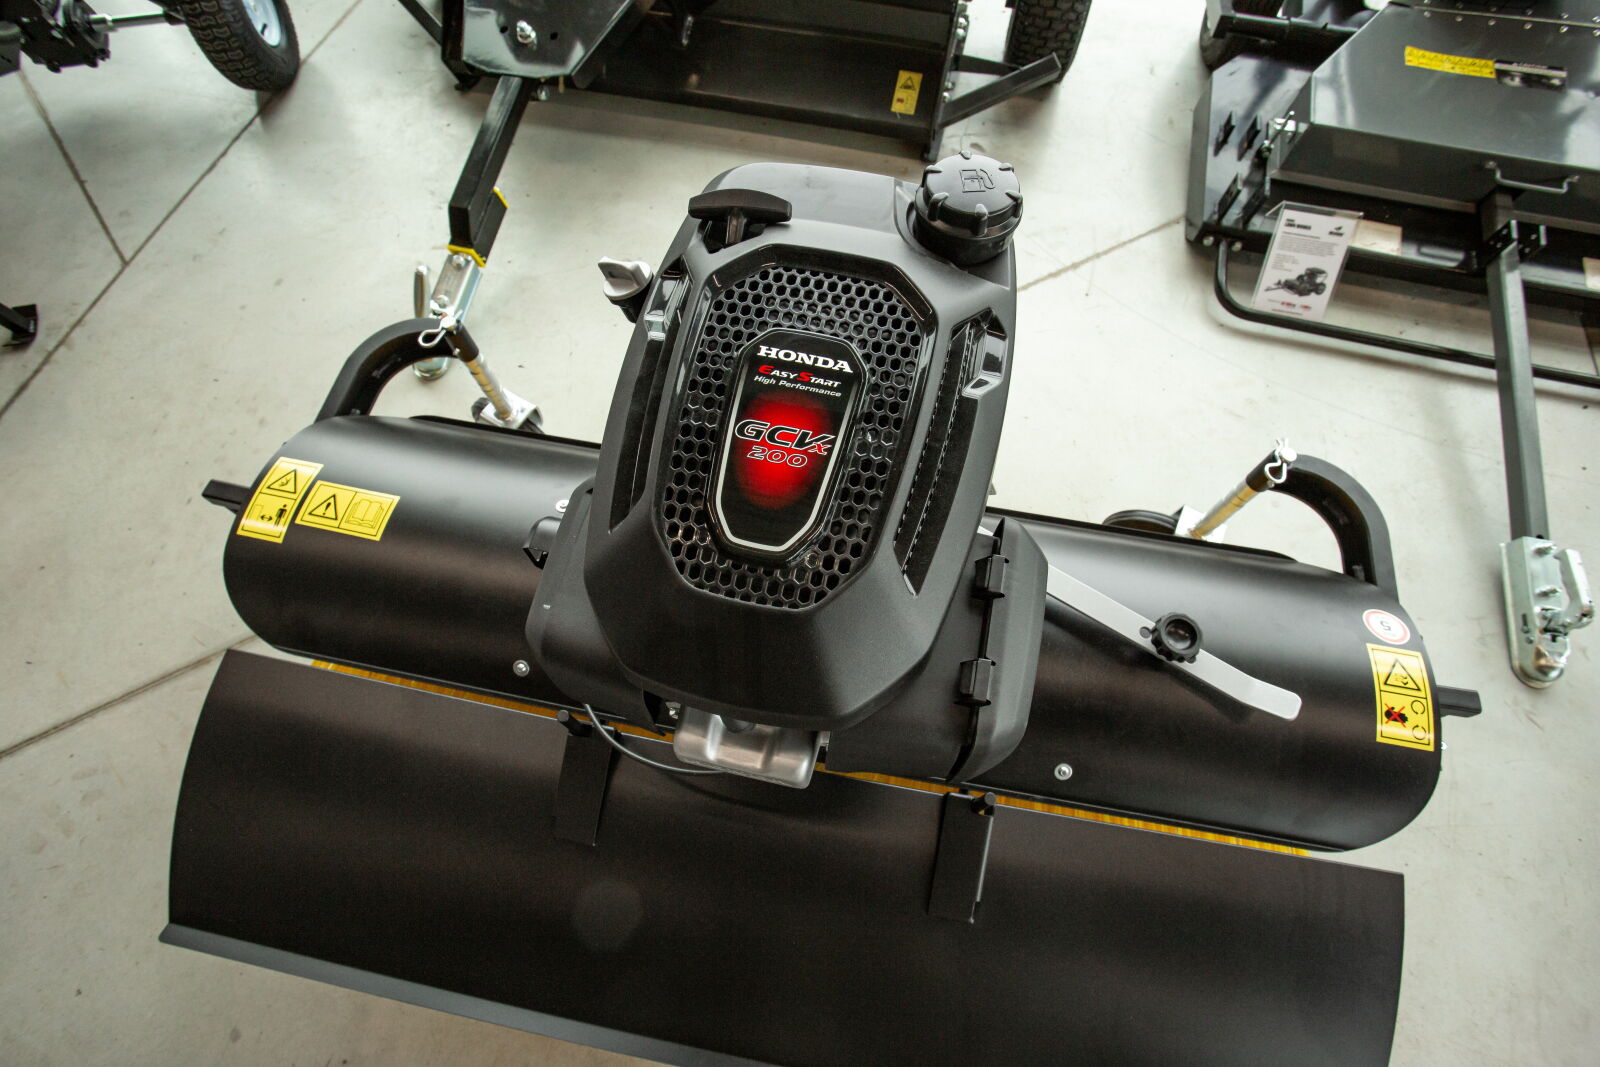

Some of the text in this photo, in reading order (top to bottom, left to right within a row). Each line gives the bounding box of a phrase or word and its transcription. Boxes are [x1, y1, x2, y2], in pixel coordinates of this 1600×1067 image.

[757, 345, 854, 373] HONDA
[753, 375, 842, 397] High Performance
[746, 445, 808, 467] 200
